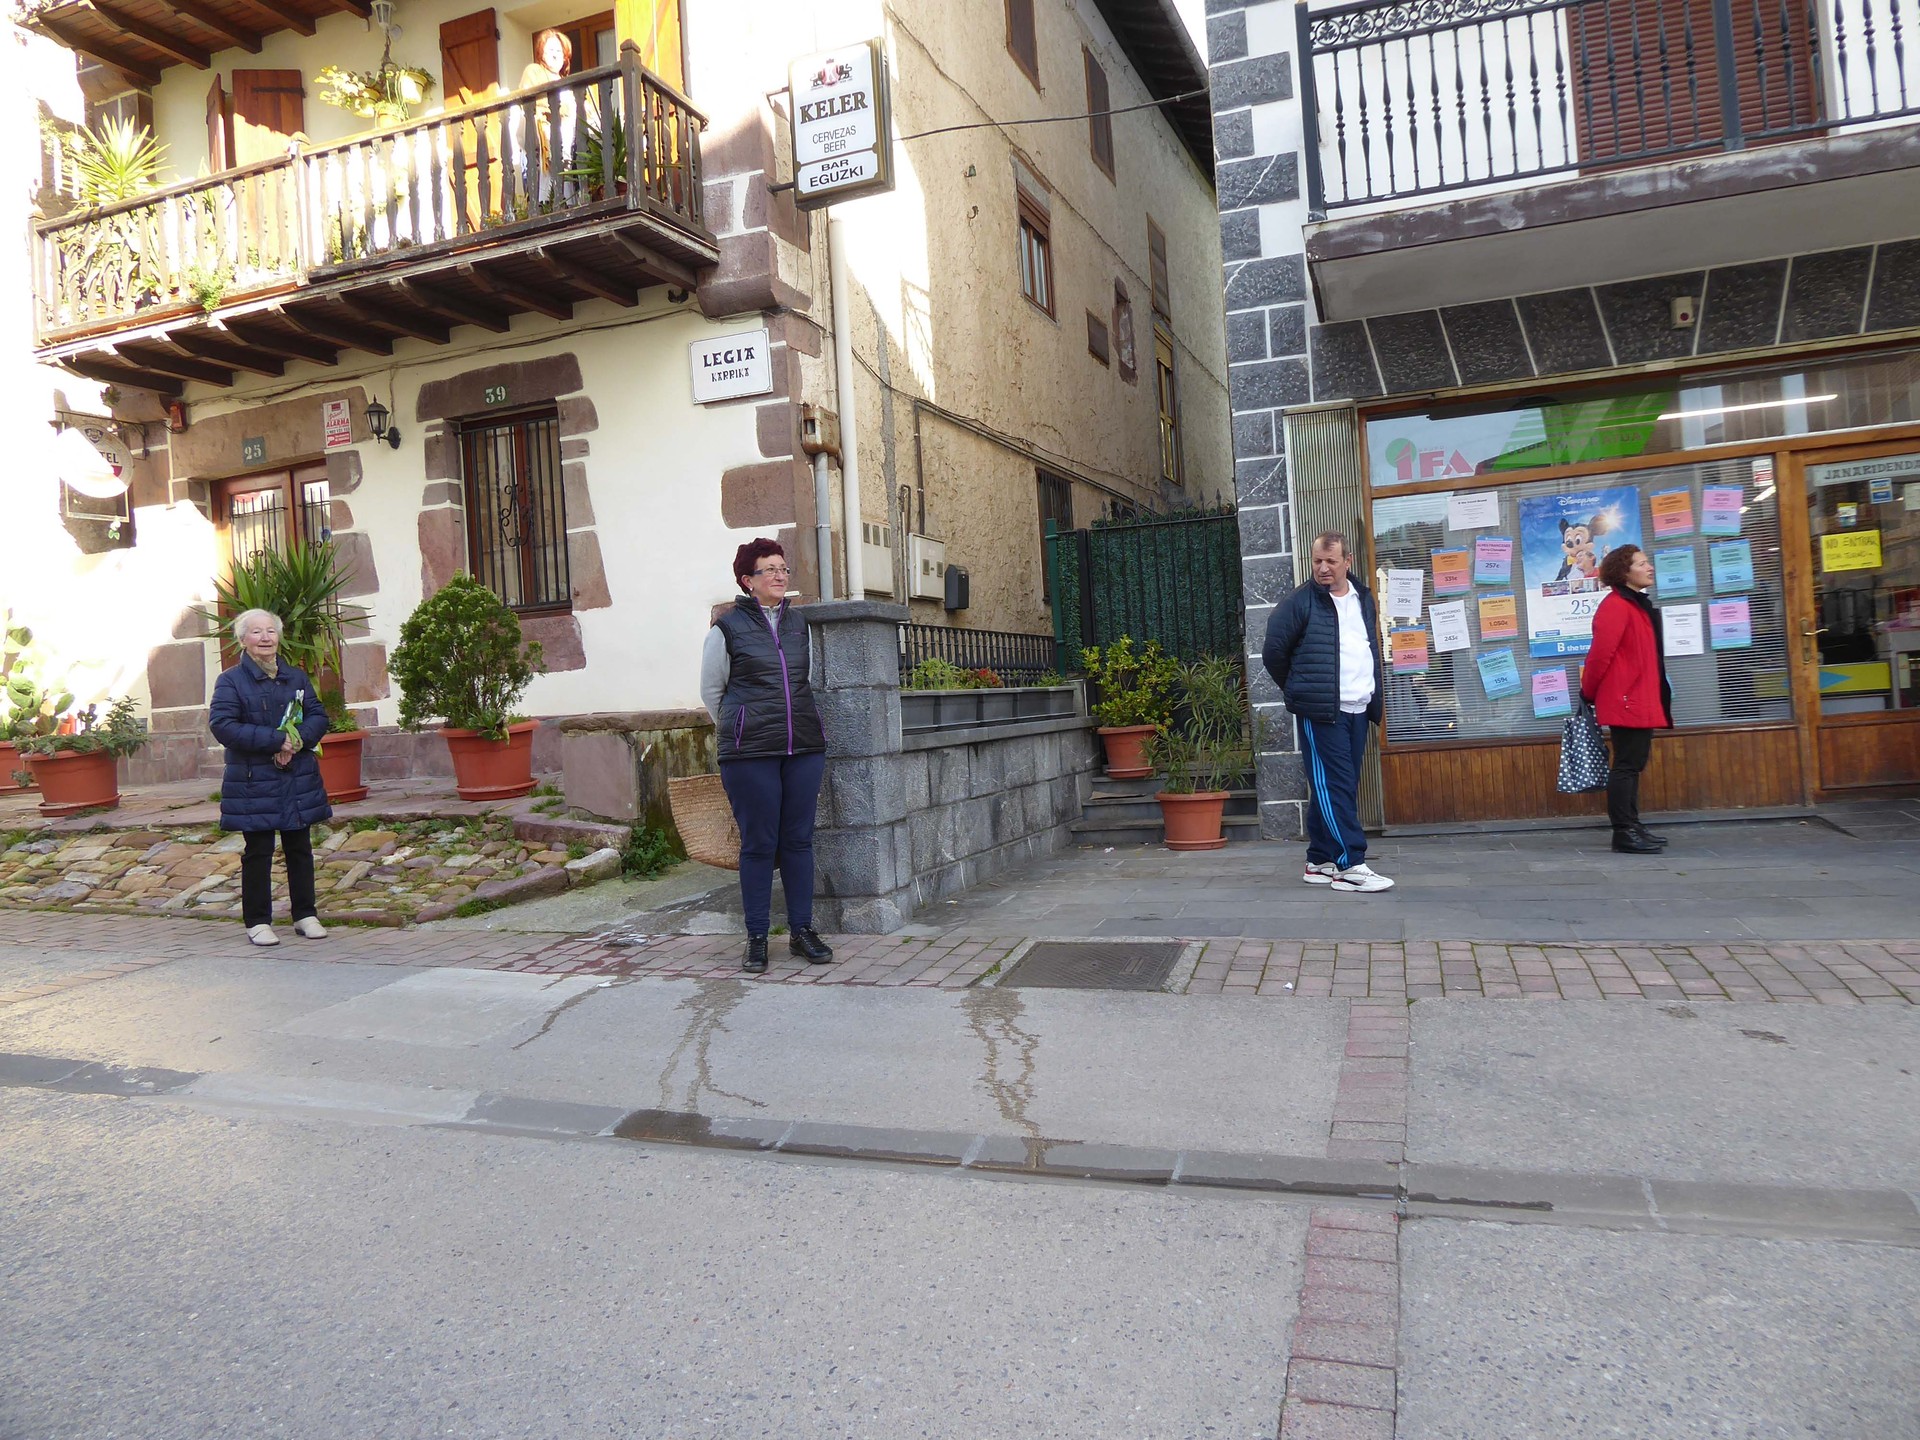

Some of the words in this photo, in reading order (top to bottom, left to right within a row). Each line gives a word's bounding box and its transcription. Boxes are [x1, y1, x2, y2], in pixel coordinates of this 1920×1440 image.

[800, 91, 868, 124] KELER
[812, 125, 857, 145] CERVEZAS
[824, 139, 846, 154] BEER
[821, 159, 849, 172] BAR
[810, 165, 863, 188] EGUZKI
[703, 346, 755, 368] LEGIA
[711, 367, 750, 382] KARRIKA
[485, 386, 506, 404] 39
[326, 417, 350, 428] ALARMA
[244, 444, 262, 460] 25
[1557, 642, 1566, 652] B
